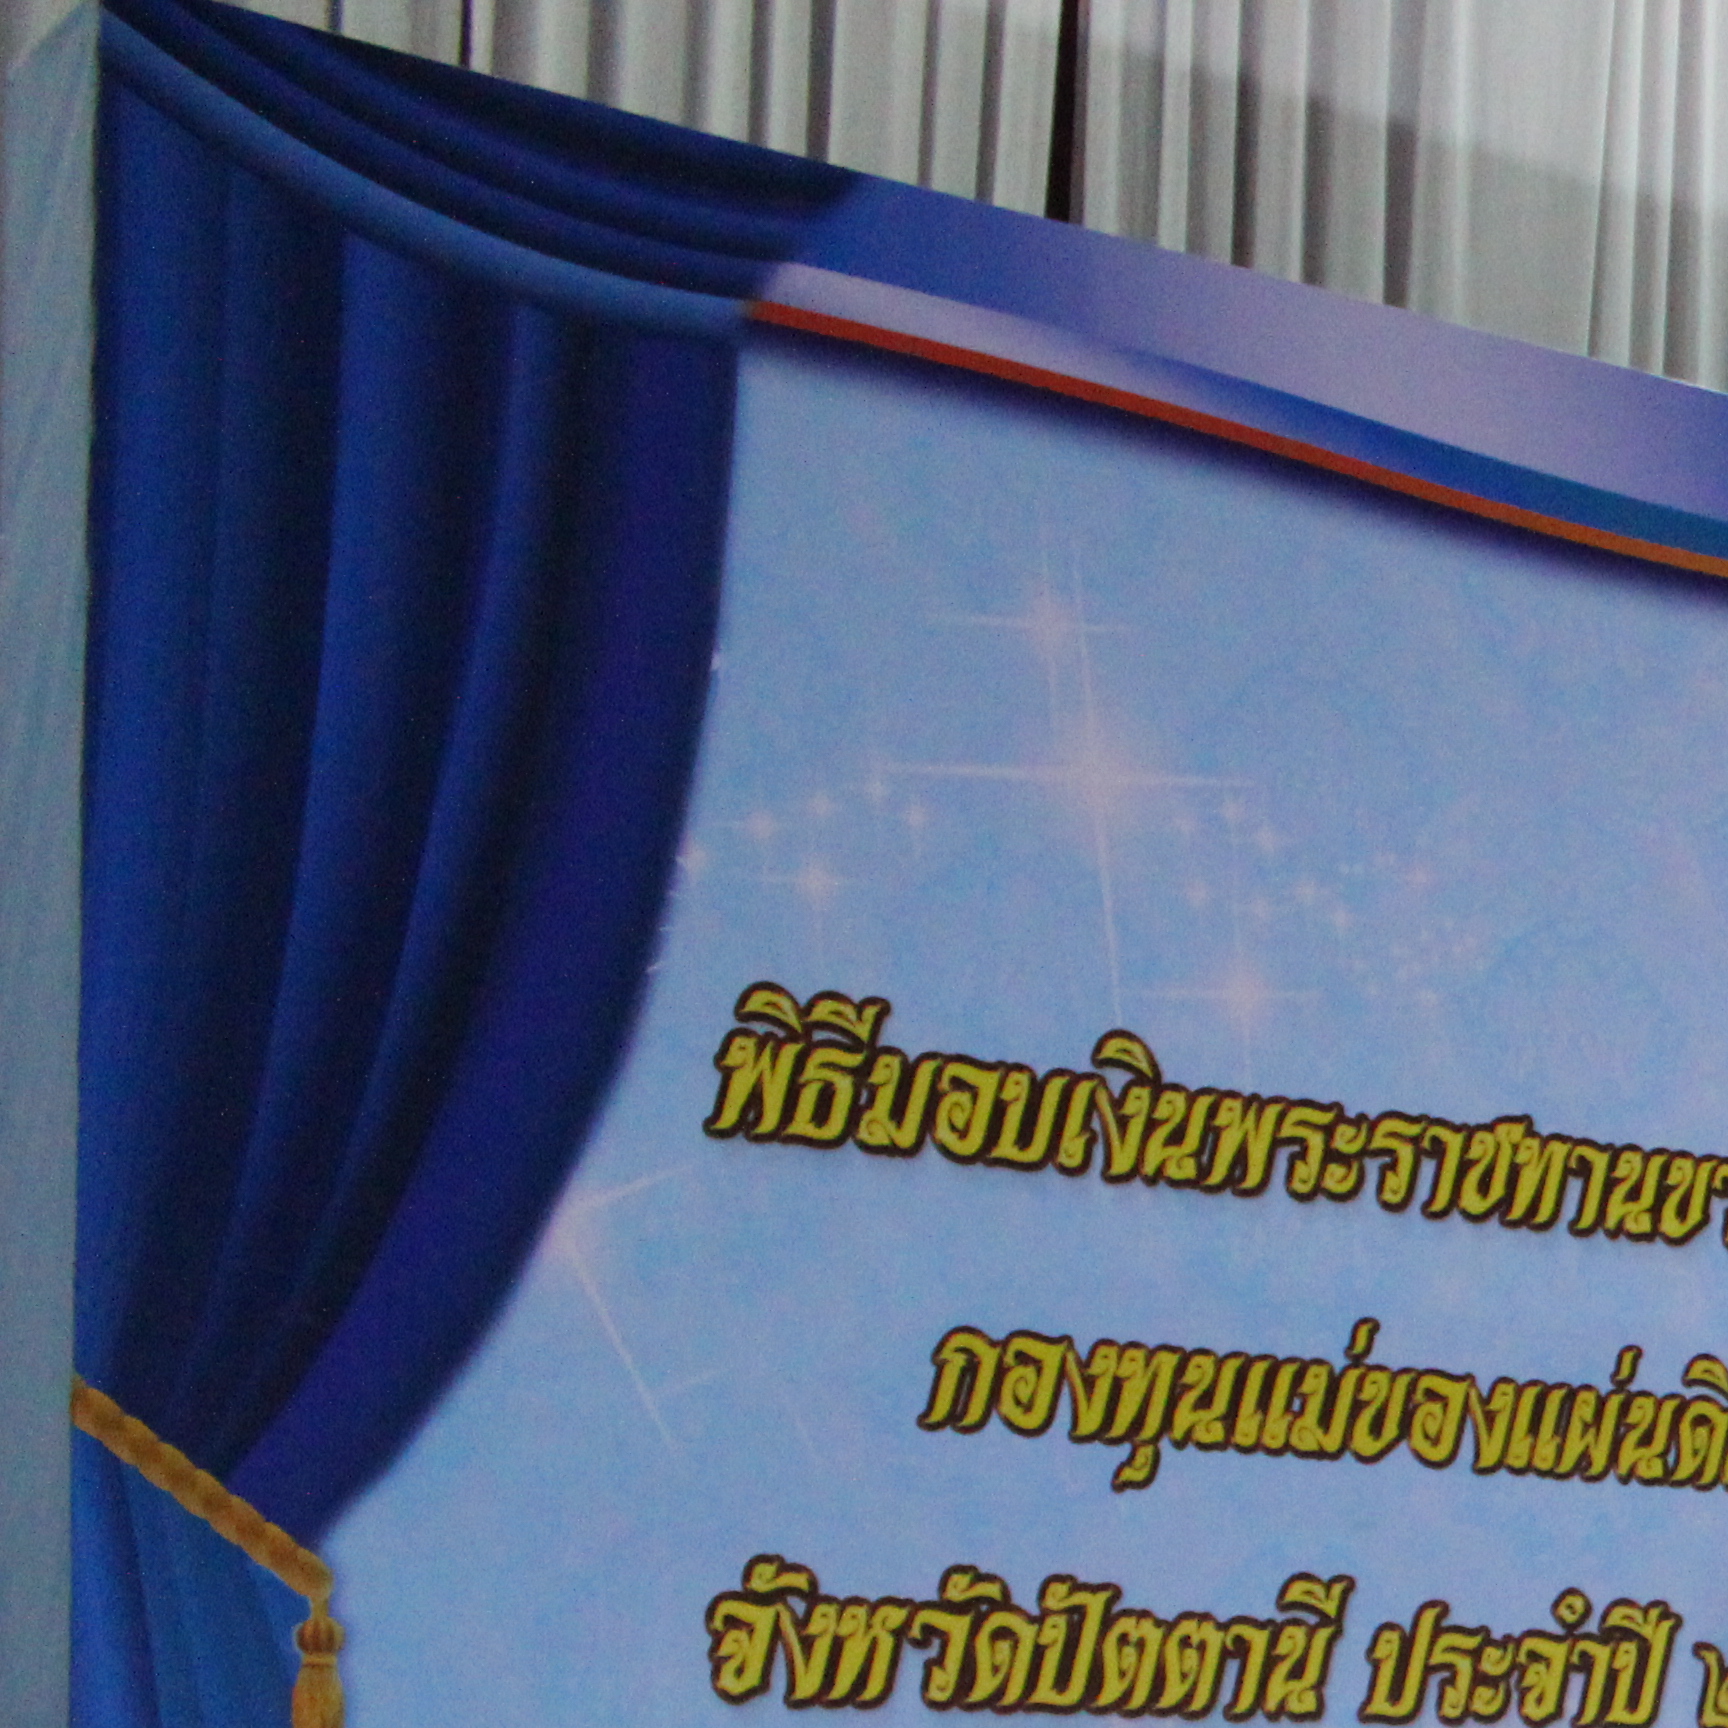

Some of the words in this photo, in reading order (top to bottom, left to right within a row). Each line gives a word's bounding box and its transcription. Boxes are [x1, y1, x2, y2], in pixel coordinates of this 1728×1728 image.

[704, 1553, 1356, 1723] จังหวัดปัตตานี
